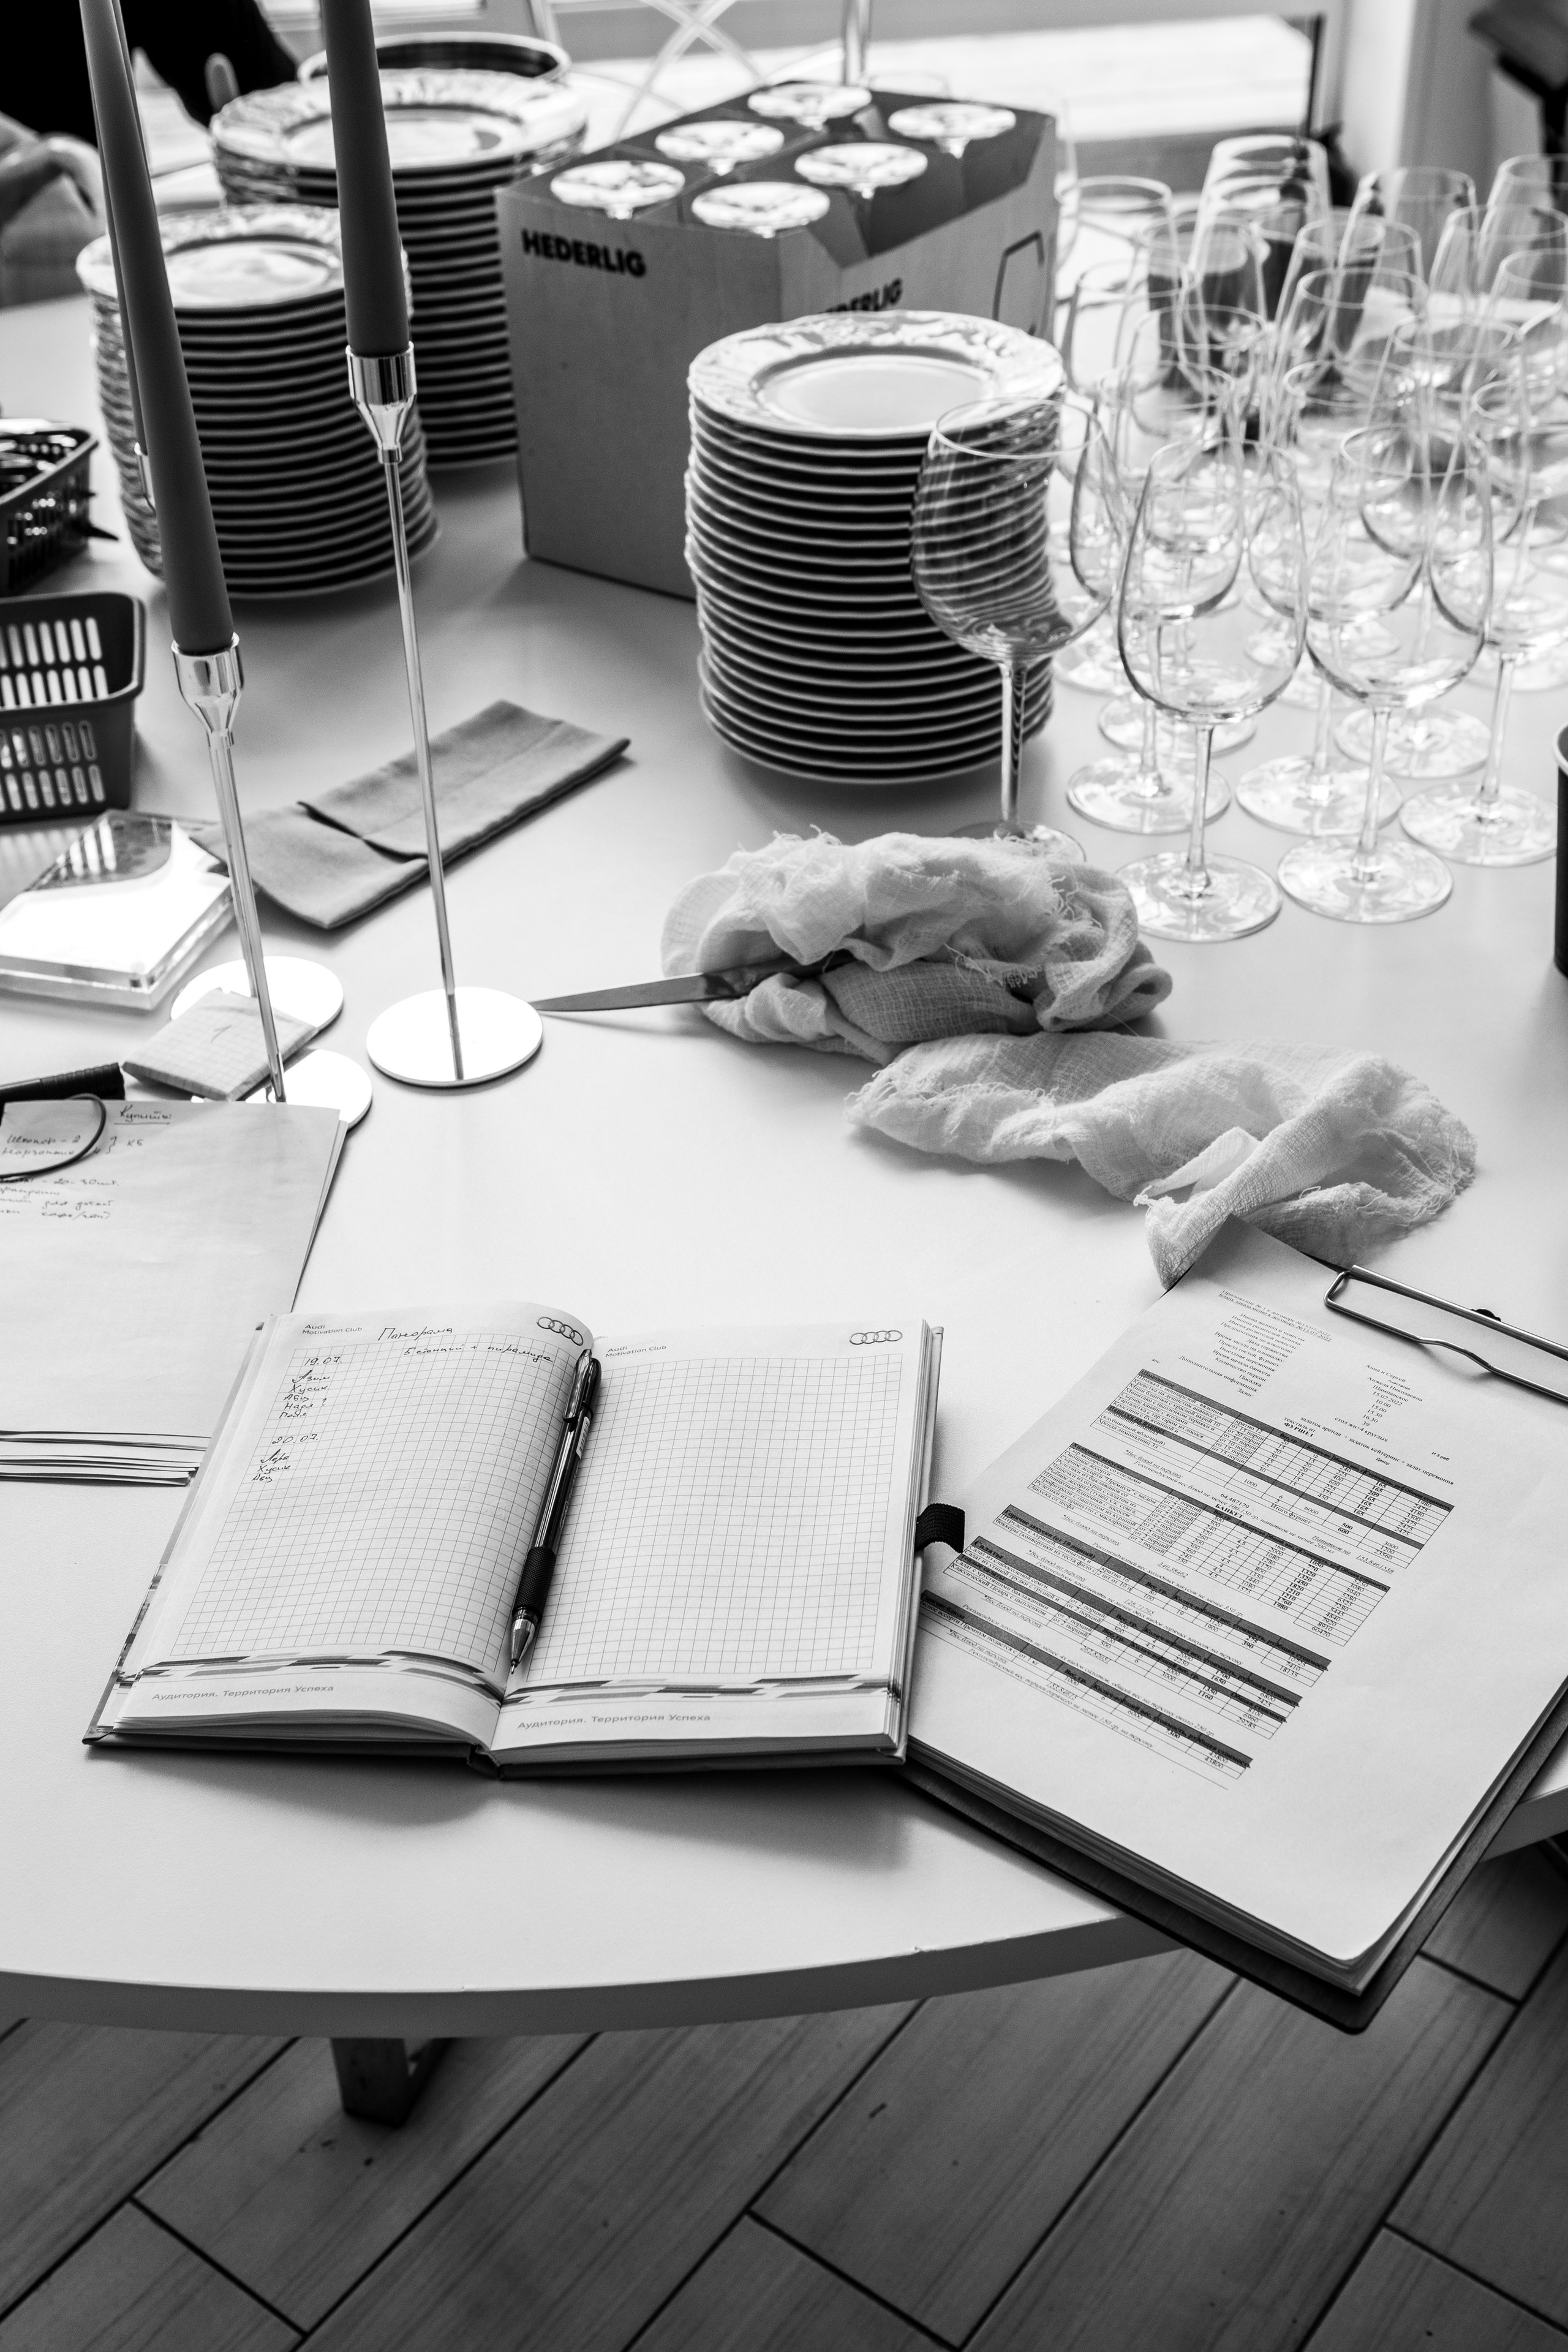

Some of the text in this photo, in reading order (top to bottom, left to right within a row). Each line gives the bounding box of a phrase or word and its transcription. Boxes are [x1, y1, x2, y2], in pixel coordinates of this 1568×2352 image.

[521, 228, 646, 277] HEDERLIG
[378, 1327, 453, 1341] Панорама
[488, 1344, 554, 1363] пирамида
[605, 1348, 647, 1357] Motivation
[1366, 1376, 1423, 1402] Анжела Николаевна
[1372, 1384, 1409, 1402] Шампанское
[1372, 1391, 1403, 1406] 15.07.2022
[1283, 1416, 1309, 1430] текстиль
[1283, 1422, 1314, 1438] ФУРШЕТ
[1299, 1415, 1322, 1428] задаток
[1321, 1425, 1343, 1437] аренда
[1348, 1437, 1371, 1450] задаток
[1370, 1447, 1401, 1463] кейтеринг
[1404, 1462, 1422, 1472] задат
[1421, 1469, 1455, 1486] церемония
[1063, 1451, 1111, 1477] Овощное ассорти
[1375, 1457, 1390, 1465] Декор
[1028, 1484, 1054, 1498] Закуска
[1057, 1500, 1075, 1510] шефа
[1215, 1503, 1243, 1518] БАНКЕТ
[1303, 1506, 1319, 1515] 6000
[1340, 1522, 1354, 1531] 500
[1373, 1549, 1393, 1561] 23560
[1300, 1568, 1316, 1578] 1320
[1306, 1564, 1319, 1572] 770
[1288, 1582, 1305, 1592] 1820
[1272, 1601, 1289, 1611] 1980
[1276, 1596, 1293, 1607] 1760
[1310, 1626, 1331, 1638] 60470
[1240, 1640, 1254, 1649] 390
[1278, 1665, 1298, 1678] 18135
[1210, 1675, 1227, 1685] 1650
[152, 1692, 218, 1701] Аудитория.
[223, 1686, 291, 1697] Территория
[1197, 1690, 1214, 1701] 1160
[517, 1717, 587, 1730] Аудитория.
[1235, 1716, 1257, 1730] 29285
